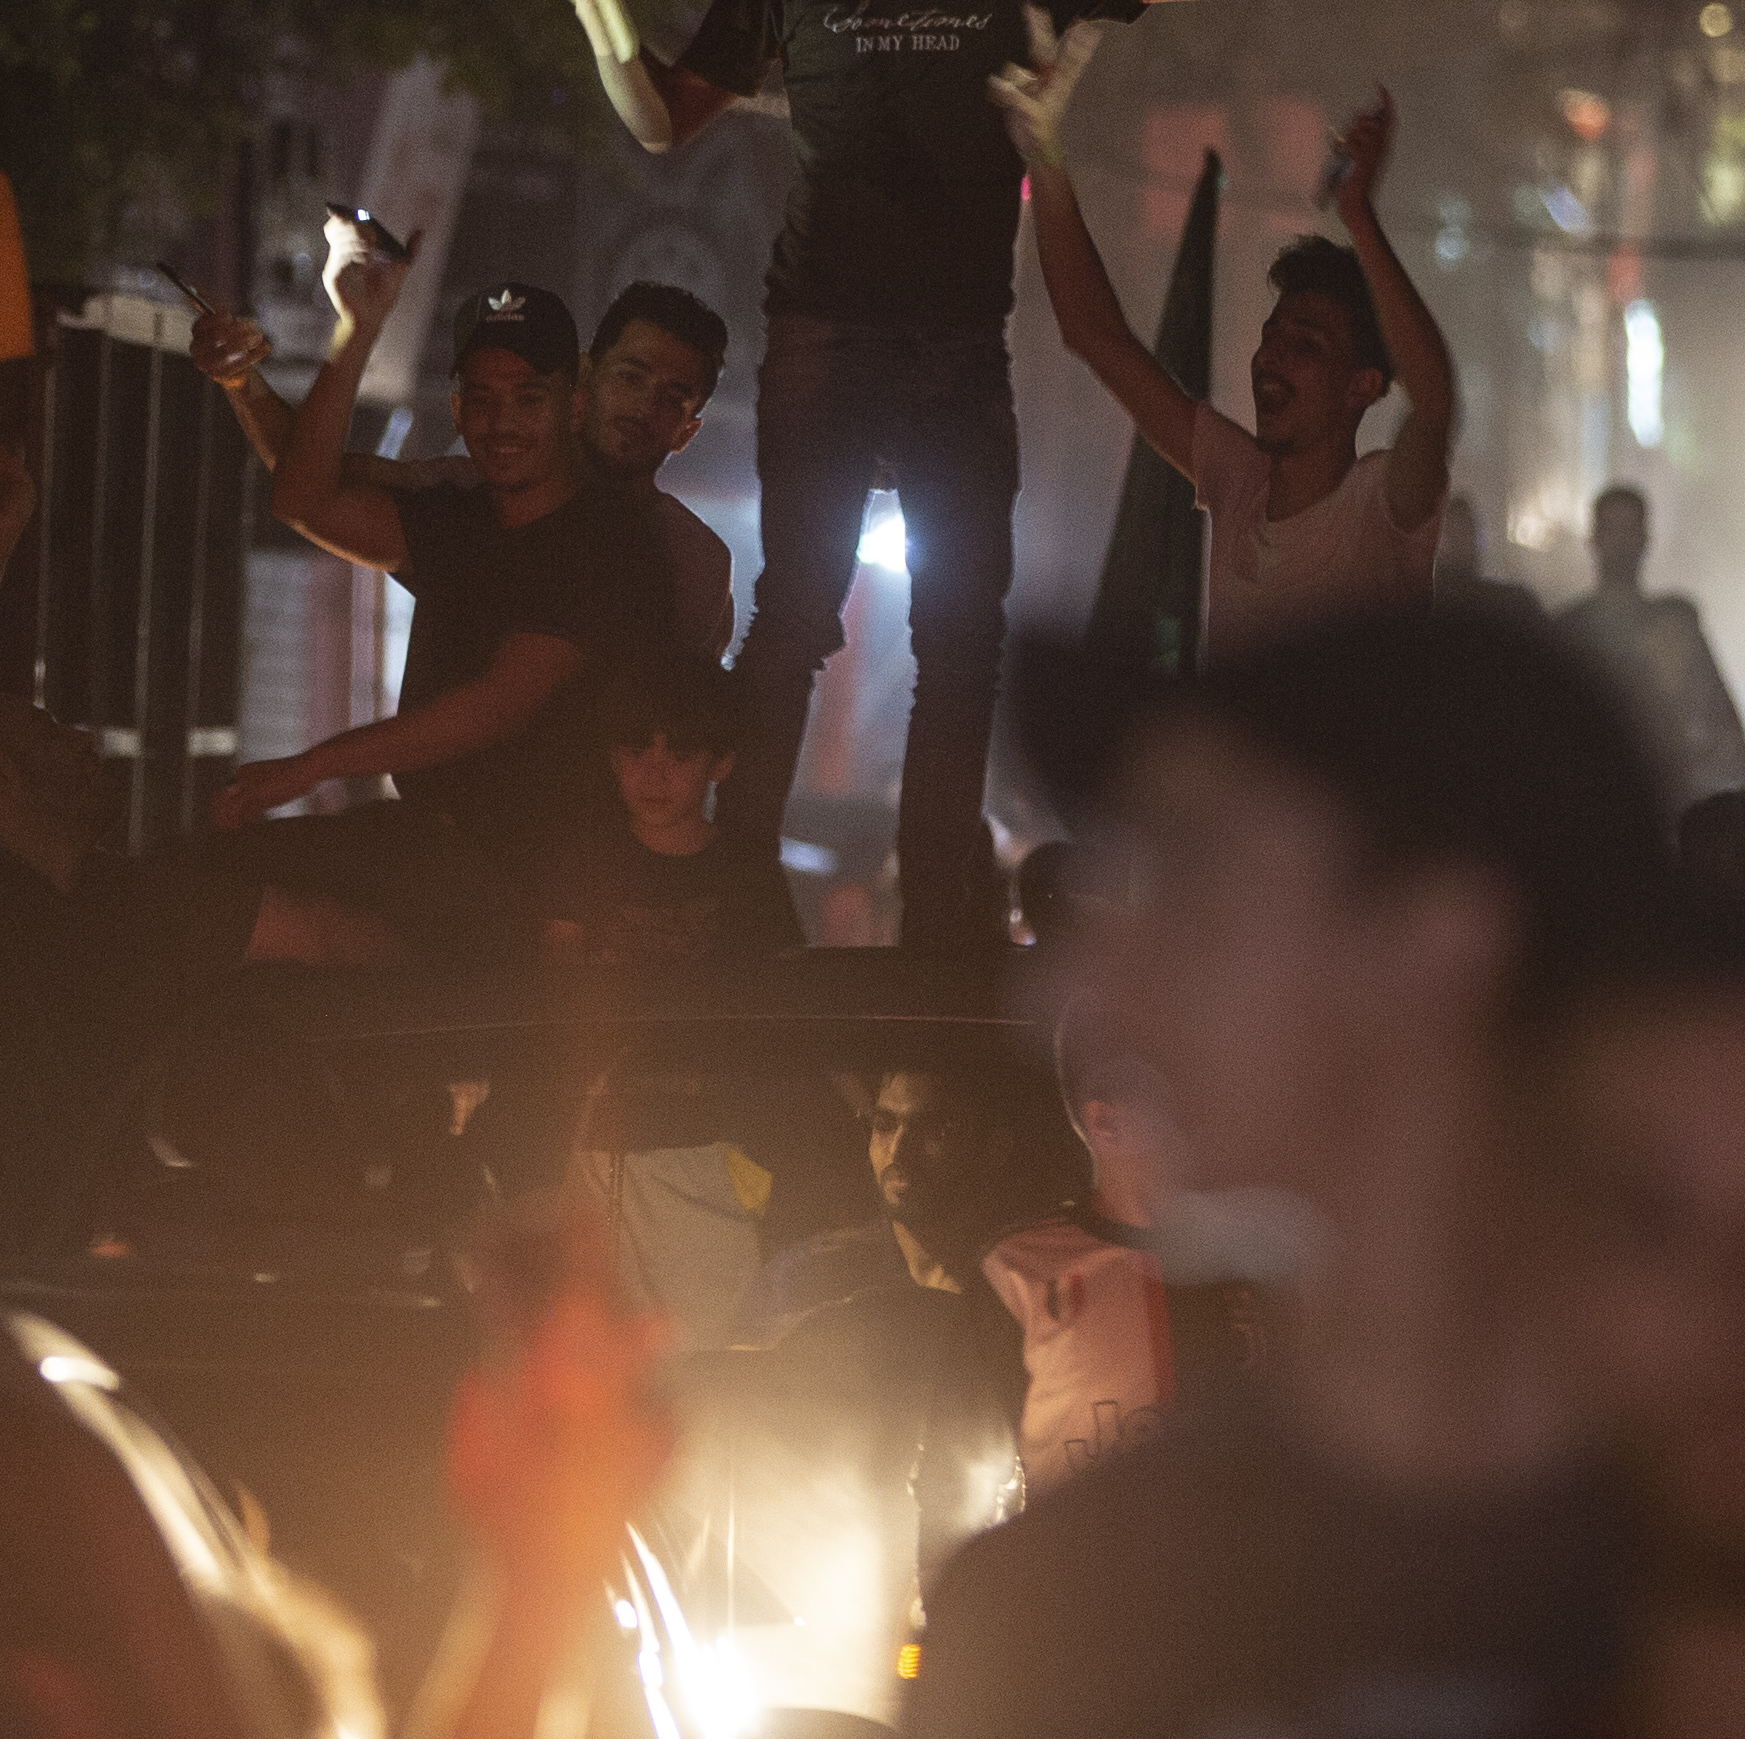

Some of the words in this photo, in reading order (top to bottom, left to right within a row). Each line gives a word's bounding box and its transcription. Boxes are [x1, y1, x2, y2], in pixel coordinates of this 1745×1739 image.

[855, 36, 873, 53] IN
[877, 34, 903, 51] MY
[912, 34, 960, 51] HEAD
